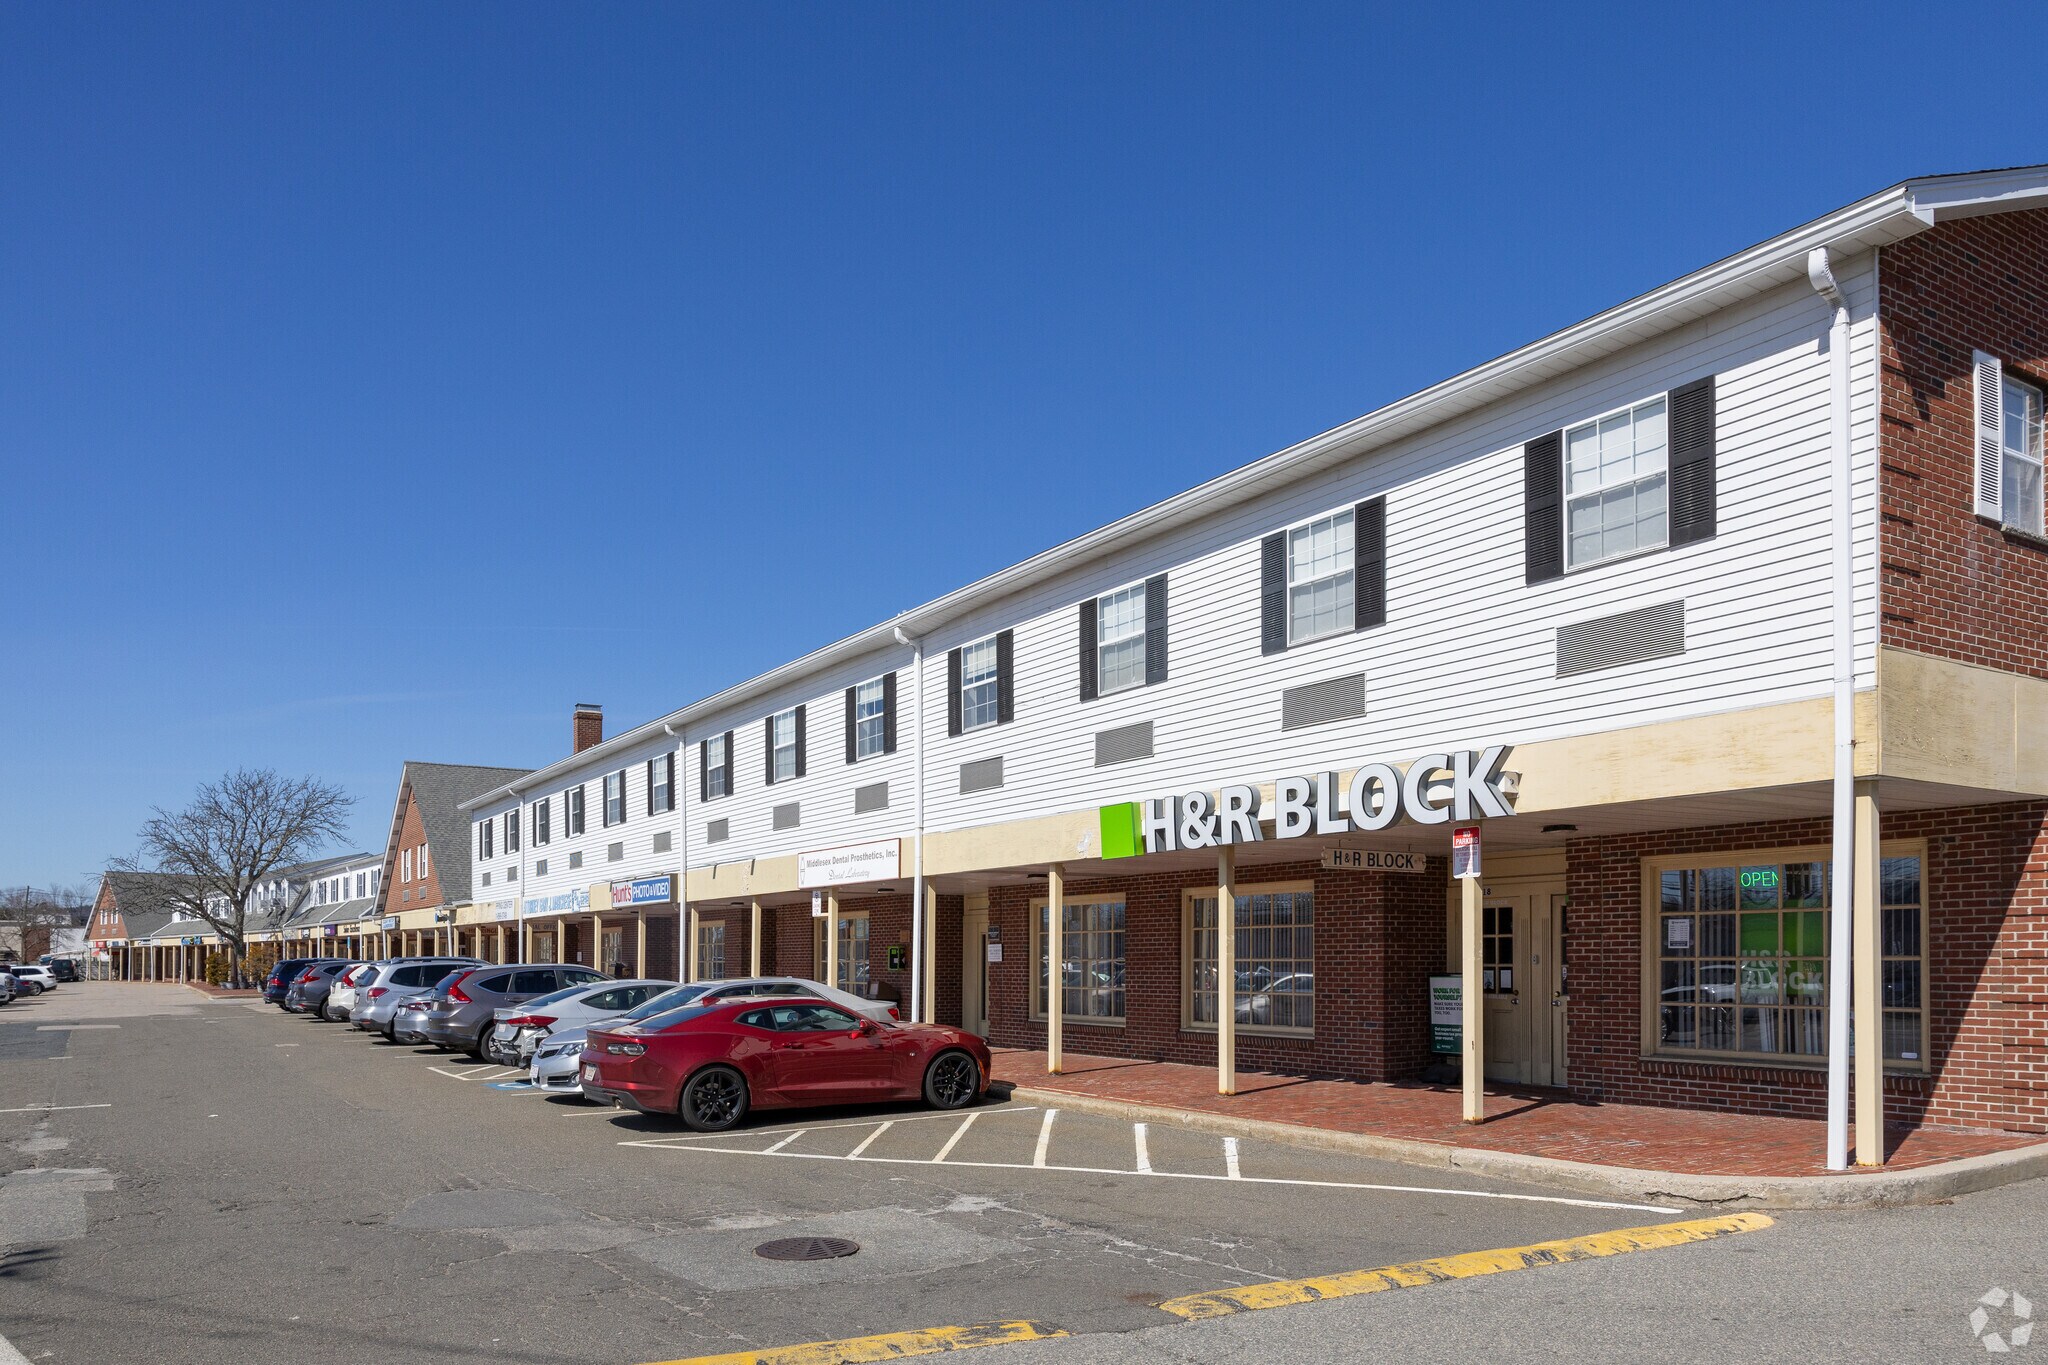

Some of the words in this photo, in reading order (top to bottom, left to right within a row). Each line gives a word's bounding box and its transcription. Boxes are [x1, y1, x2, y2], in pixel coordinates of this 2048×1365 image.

[1145, 784, 1264, 853] H&R
[1275, 745, 1517, 840] BLOCK
[1456, 837, 1478, 845] PARKING
[806, 858, 831, 868] Middlesex
[832, 855, 849, 864] Dental
[850, 851, 884, 862] Prosthetics,
[886, 849, 897, 858] Inc.
[1367, 852, 1414, 869] BLOCK
[612, 884, 632, 903] Hunt's
